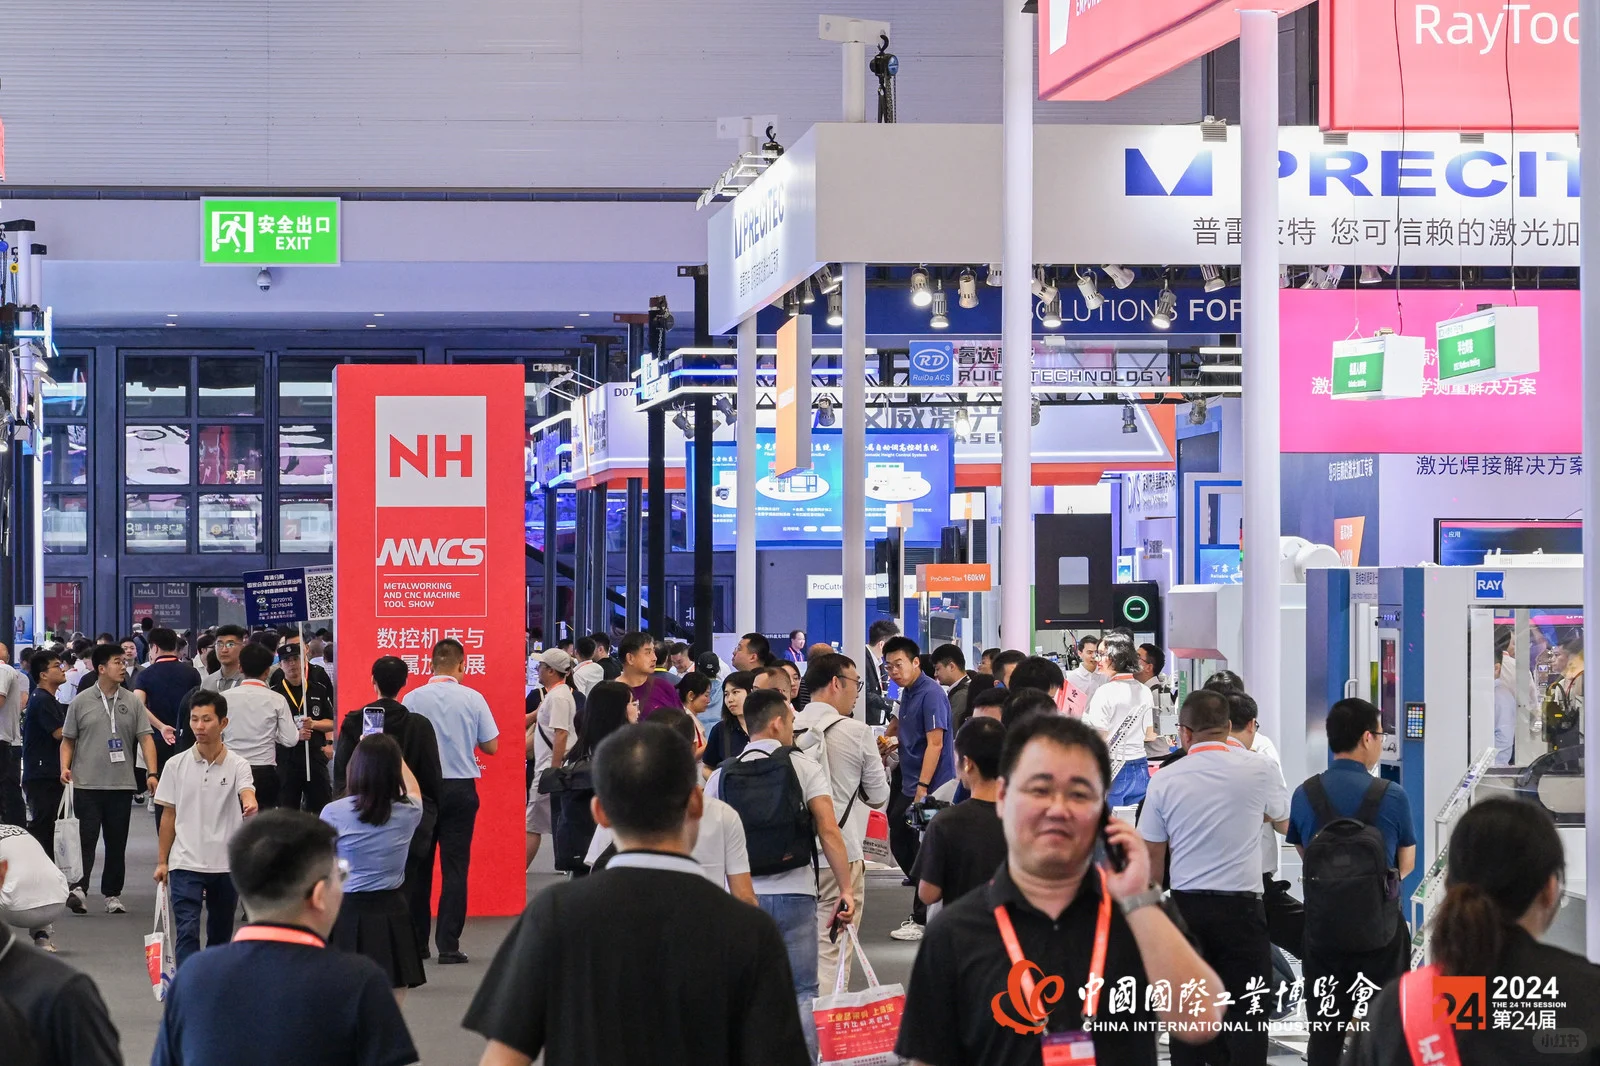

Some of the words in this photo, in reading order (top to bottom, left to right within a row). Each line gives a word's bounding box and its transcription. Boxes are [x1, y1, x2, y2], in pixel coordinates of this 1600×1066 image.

[258, 215, 330, 234] 安全出口
[1192, 217, 1316, 246] 普雷特
[275, 237, 311, 250] EXIT
[919, 354, 946, 367] RD
[912, 373, 934, 382] RuiDa
[935, 373, 950, 382] ACS
[1031, 370, 1167, 383] TECHNOLOGY
[389, 433, 473, 478] NH
[1416, 455, 1583, 476] 激光焊接解决方案
[376, 538, 487, 566] MWCS
[963, 573, 986, 582] 160kW
[383, 582, 452, 590] METALWORKING
[383, 591, 402, 599] AND
[404, 591, 421, 599] CNC
[423, 591, 461, 599] MACHINE
[383, 600, 406, 608] TOOL
[408, 600, 434, 608] SHOW
[377, 627, 485, 649] 数控机床与
